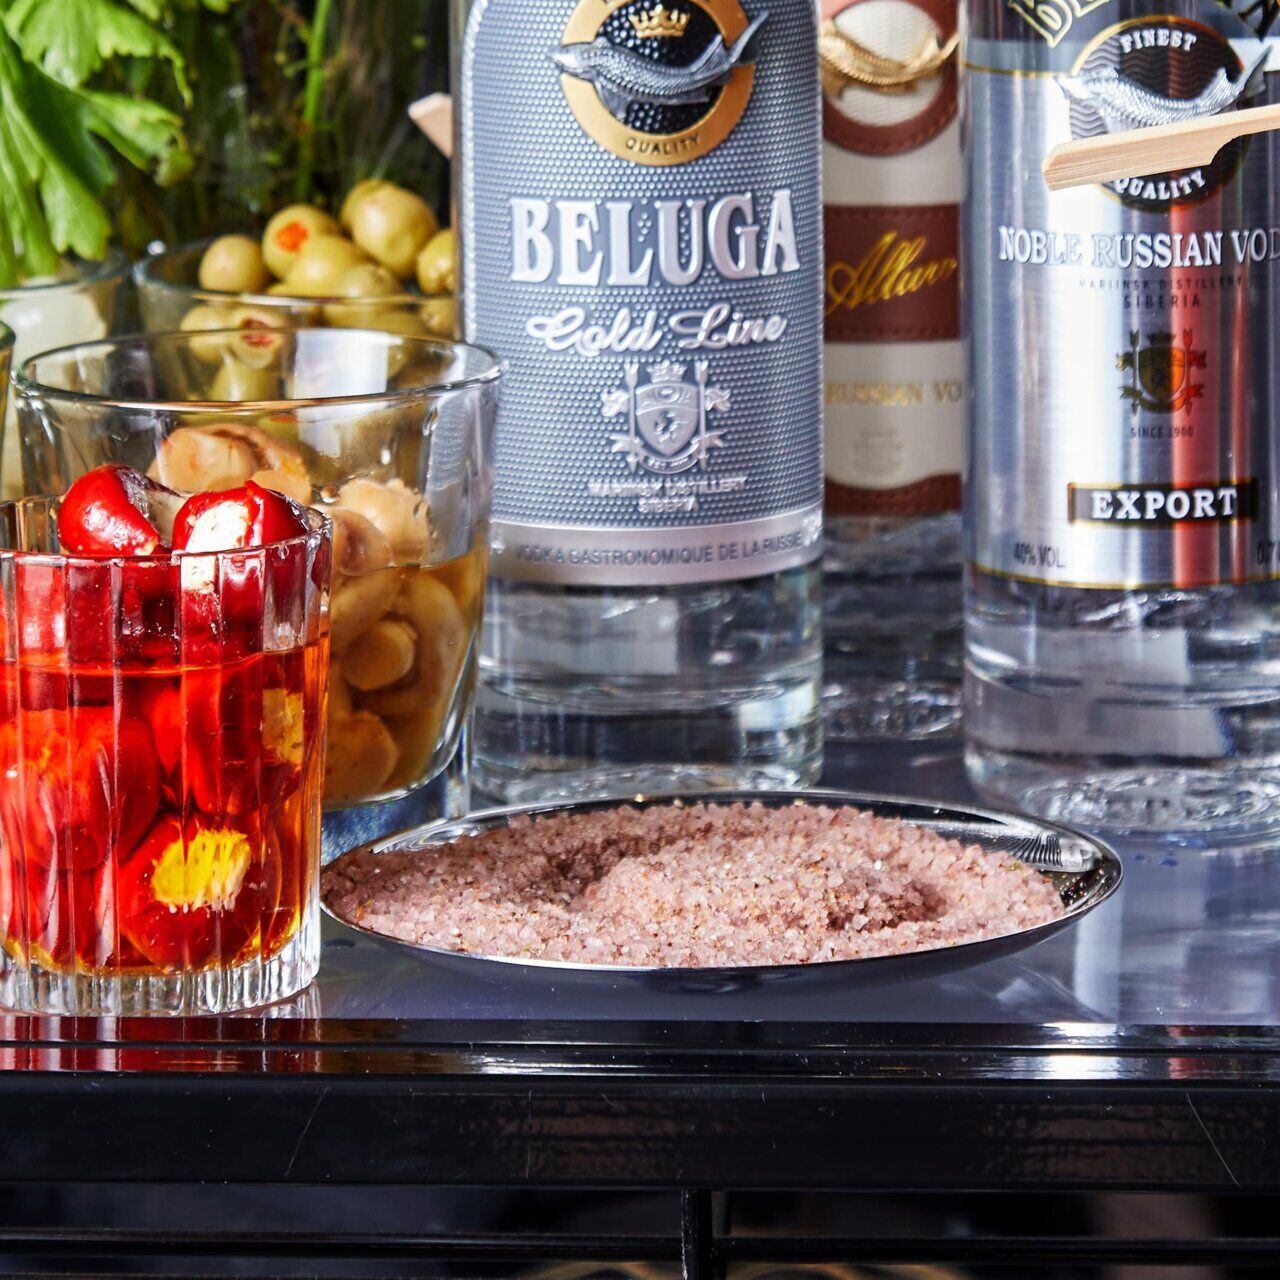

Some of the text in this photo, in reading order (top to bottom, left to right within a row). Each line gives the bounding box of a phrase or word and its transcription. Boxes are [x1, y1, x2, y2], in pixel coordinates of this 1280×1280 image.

[1119, 27, 1197, 53] FINEST
[625, 133, 699, 155] QUALITY
[1114, 169, 1205, 200] QUALITY
[510, 188, 801, 287] BELUGA
[998, 225, 1083, 266] NOBLE
[1091, 230, 1223, 269] RUSSIAN
[1160, 276, 1243, 290] DISTILLERY
[1124, 293, 1200, 309] SIBERIA
[669, 302, 788, 350] Line
[1130, 425, 1194, 439] SINCE 1900
[1091, 486, 1238, 519] EXPORT
[569, 544, 713, 566] GASTRONOMIQUE
[718, 541, 739, 561] DE
[743, 539, 759, 558] LA
